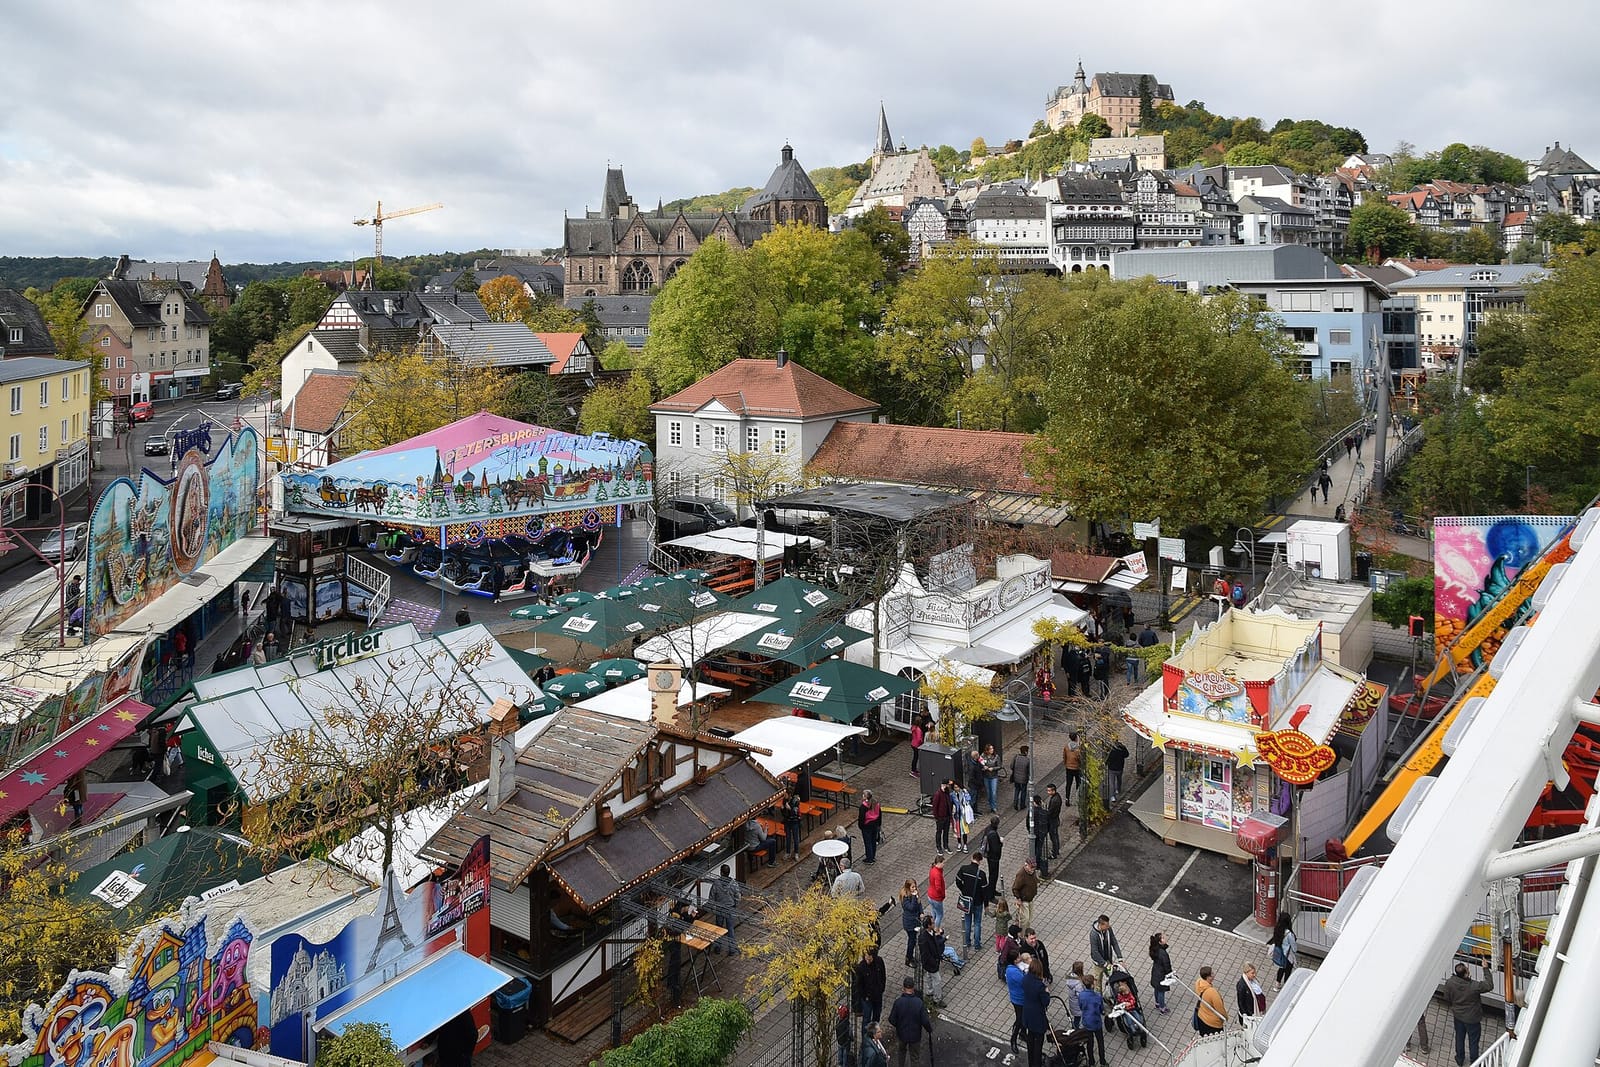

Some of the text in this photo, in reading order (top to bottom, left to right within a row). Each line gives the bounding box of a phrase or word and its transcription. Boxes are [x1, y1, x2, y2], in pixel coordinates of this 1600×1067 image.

[444, 427, 546, 465] PETERSBURGER
[568, 618, 590, 629] Licher
[1195, 673, 1225, 684] CIRCUS
[796, 684, 824, 697] Licher
[1203, 683, 1232, 693] CIRCUS
[101, 876, 133, 900] Licher
[1096, 881, 1119, 893] 32
[1198, 912, 1223, 925] 33
